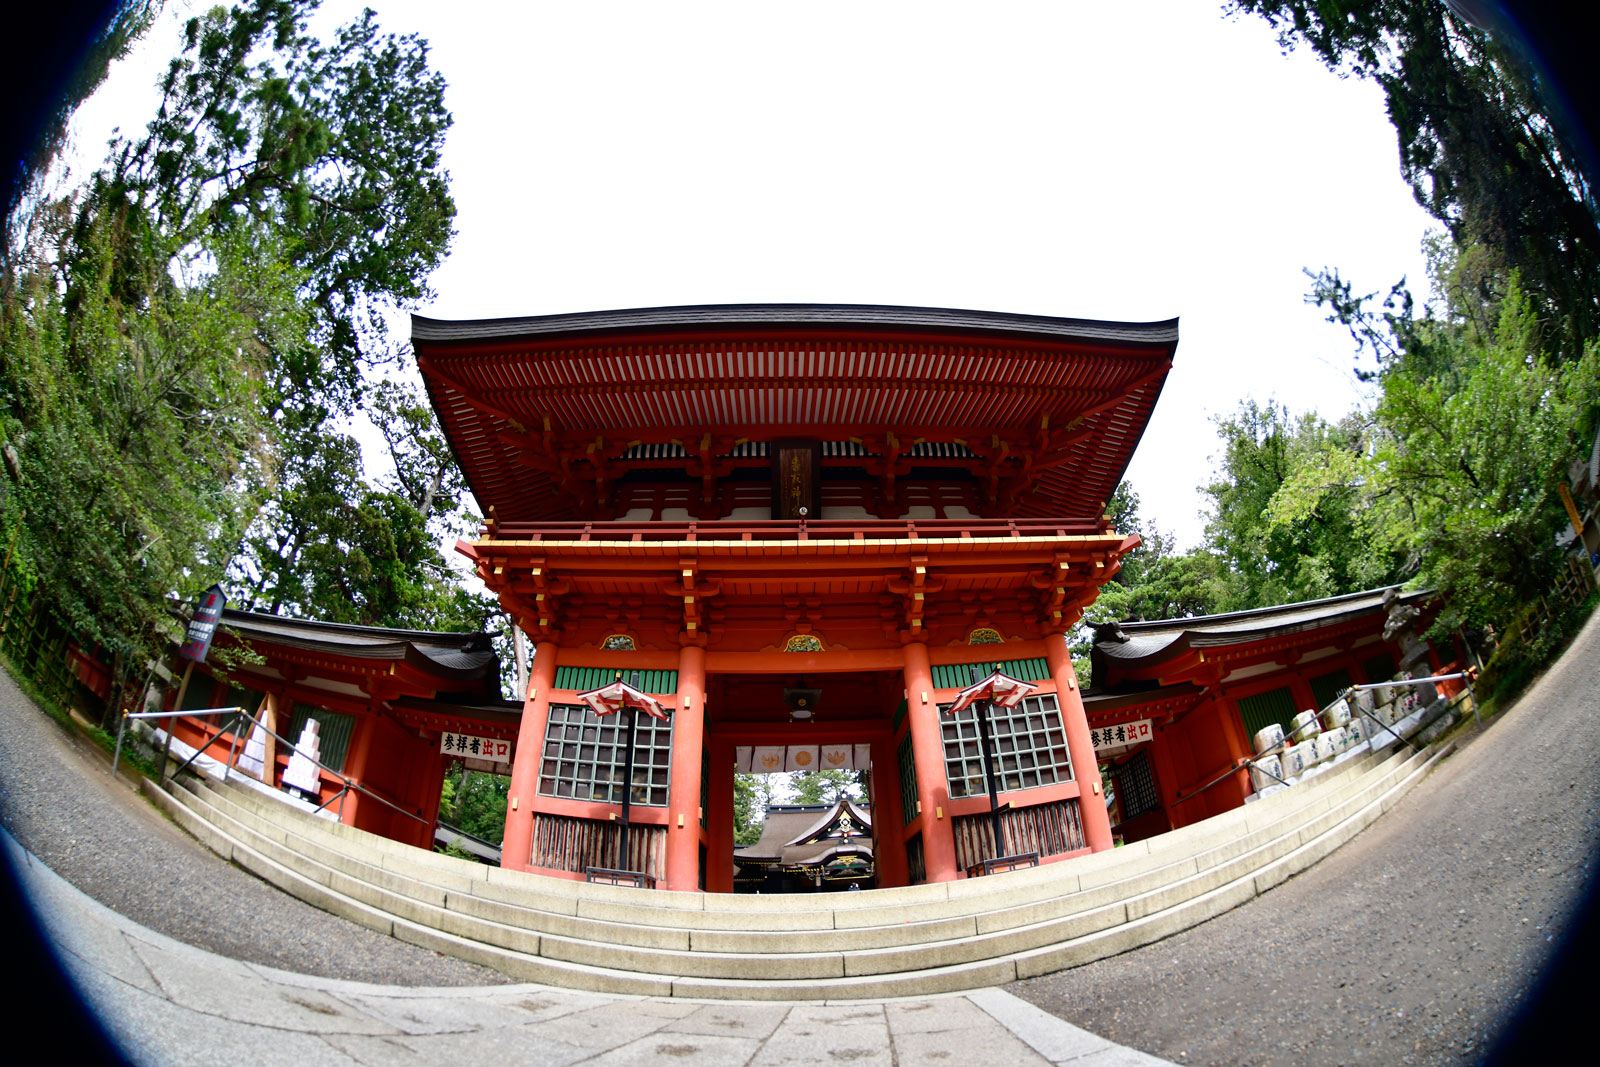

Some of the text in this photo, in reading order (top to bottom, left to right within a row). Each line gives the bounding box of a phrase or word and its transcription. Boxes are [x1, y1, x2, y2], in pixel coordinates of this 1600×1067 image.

[443, 733, 508, 757] 参拝者出口
[1091, 723, 1149, 748] 参拝者出口
